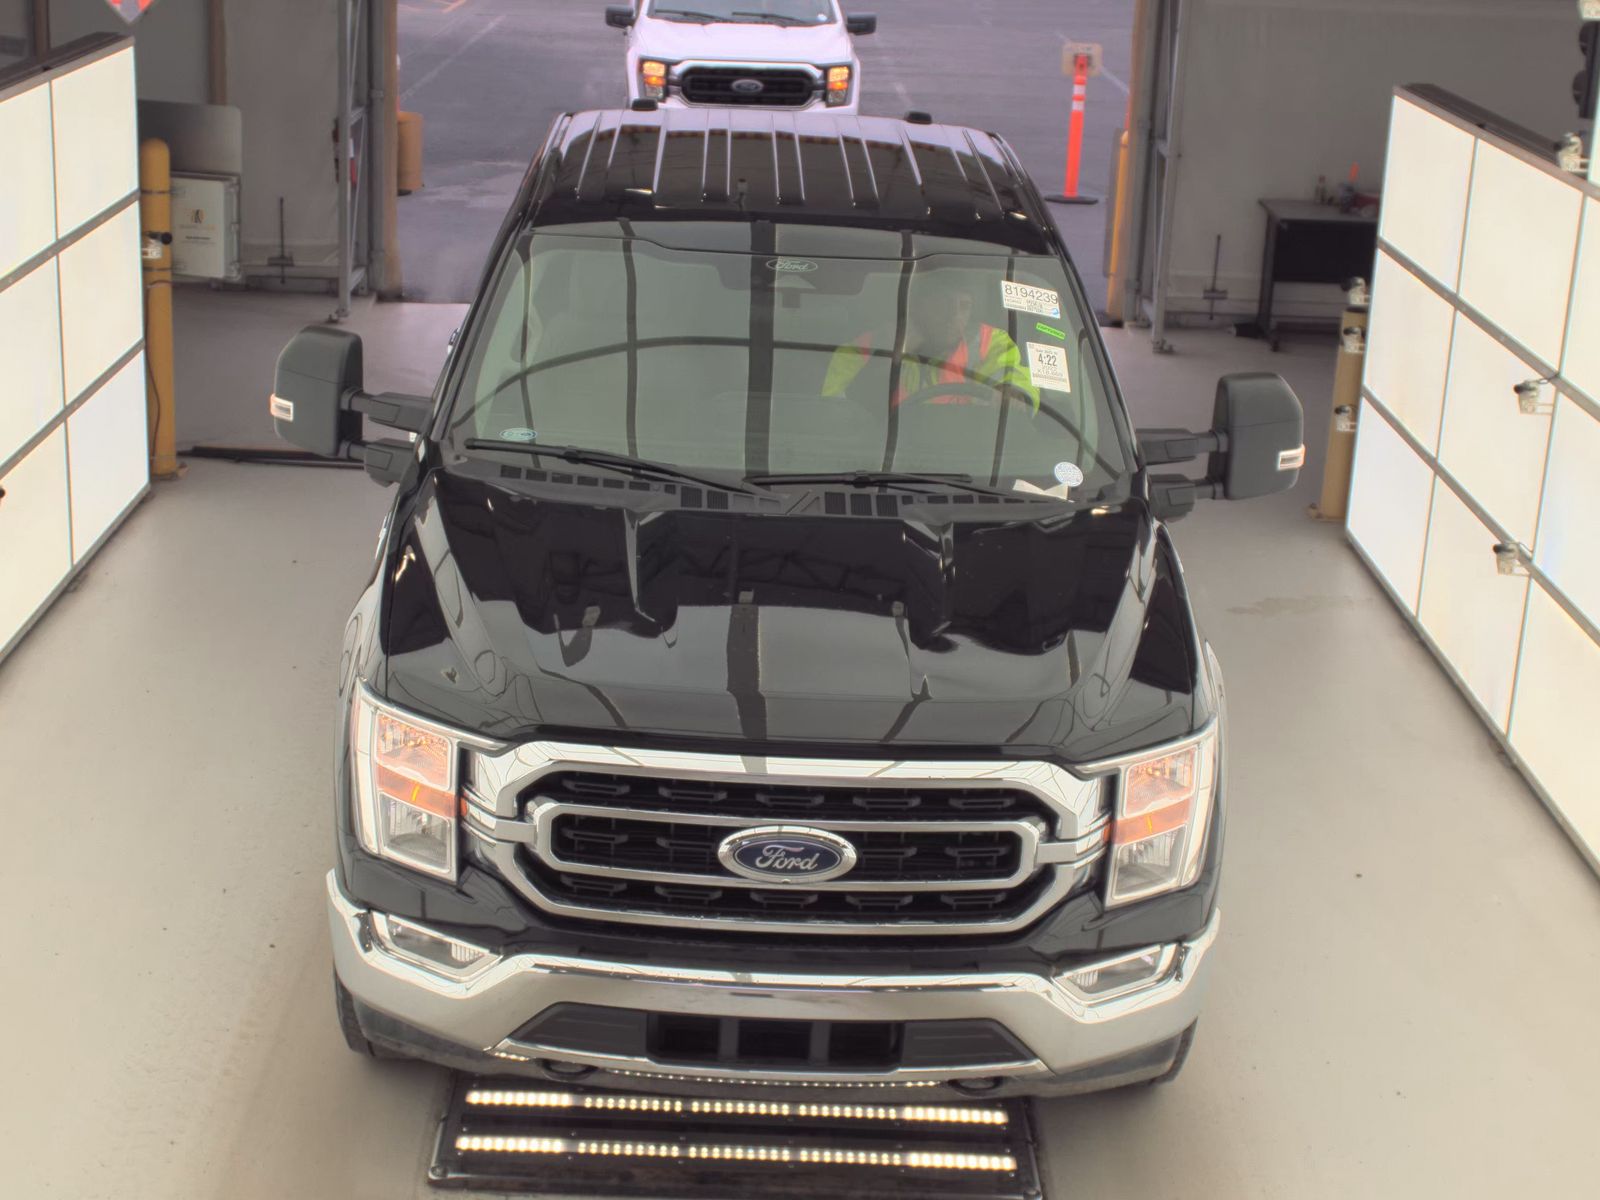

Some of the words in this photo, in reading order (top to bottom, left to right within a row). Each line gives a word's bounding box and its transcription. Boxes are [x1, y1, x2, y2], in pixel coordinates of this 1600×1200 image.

[776, 260, 809, 270] Ford
[1005, 284, 1058, 305] 8194239
[1038, 353, 1058, 367] 4:22
[755, 844, 820, 870] Ford
